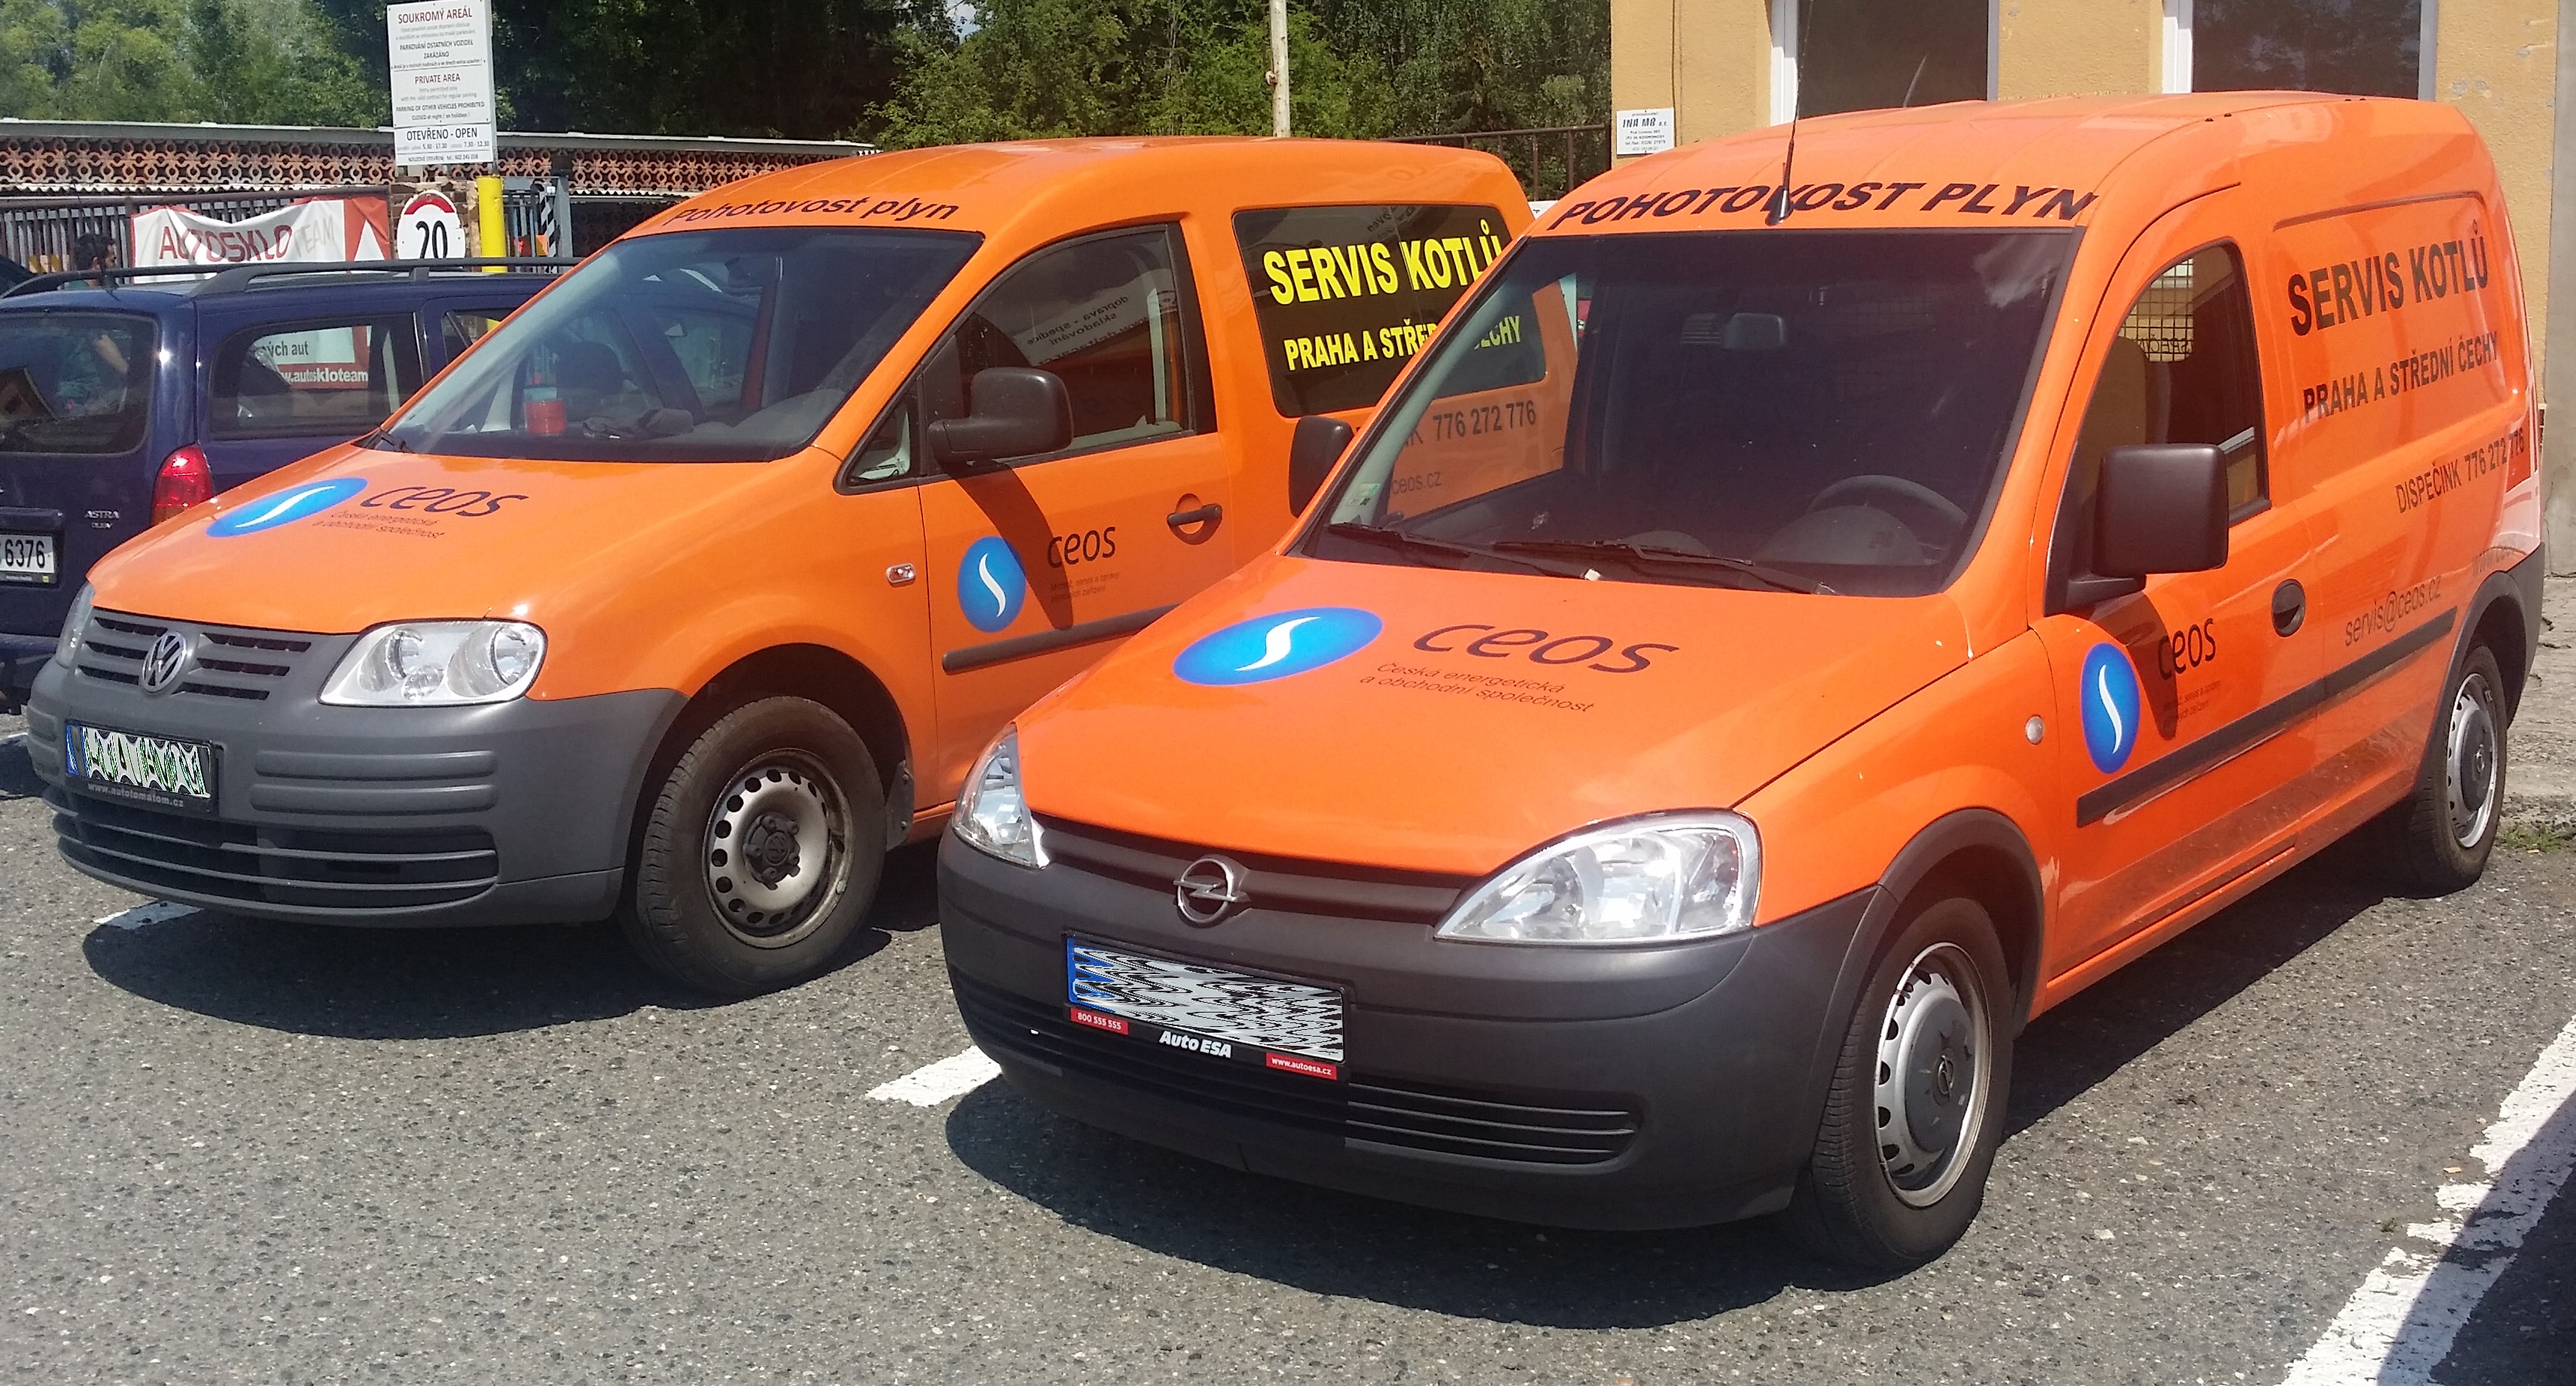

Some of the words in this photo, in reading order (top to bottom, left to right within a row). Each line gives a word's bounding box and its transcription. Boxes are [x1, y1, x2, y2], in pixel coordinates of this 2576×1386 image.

[398, 8, 444, 24] SOUKROMÝ
[446, 5, 473, 19] AREÁL
[424, 51, 449, 59] ZAKÁZÁNO
[415, 75, 442, 84] PRIVATE
[443, 73, 461, 82] AREA
[406, 128, 449, 141] OTEVŘENO
[455, 127, 478, 139] OPEN
[1642, 117, 1656, 127] MB
[662, 196, 871, 227] Pohotovost
[859, 196, 960, 222] plyn
[1546, 182, 1927, 231] POHOTOVOST
[1920, 183, 2099, 221] PLYN
[159, 224, 293, 263] AUTOSKLO
[415, 220, 449, 259] 20
[1263, 242, 1399, 306] SERVIS
[1399, 218, 1503, 292] KOTLŮ
[2288, 251, 2404, 337] SERVIS
[2408, 219, 2489, 303] KOTLŮ
[291, 340, 309, 356] aut
[1283, 332, 1360, 371] PRAHA
[1362, 330, 1379, 361] A
[2303, 372, 2369, 424] PRAHA
[2374, 367, 2386, 401] A
[2389, 337, 2454, 396] STŘEDNÍ
[2457, 331, 2498, 373] ČECHY
[1433, 410, 1466, 441] 776
[1470, 405, 1503, 435] 272
[1506, 400, 1537, 429] 776
[2395, 459, 2462, 513] DISPEČINK
[2464, 448, 2486, 482] 776
[2487, 437, 2507, 472] 272
[2508, 427, 2525, 459] 776
[84, 510, 120, 519] ASTRA
[360, 486, 530, 517] ceos
[1047, 526, 1116, 568] ceos
[2345, 574, 2442, 647] servis@ceos.cz
[1413, 624, 1679, 674] ceos
[2157, 617, 2216, 681] ceos
[1360, 675, 1376, 684] a
[1379, 675, 1472, 696] obchodní
[1475, 687, 1596, 713] společnost
[1377, 662, 1442, 678] Česká
[1443, 669, 1566, 694] energetická
[1077, 1012, 1092, 1022] 800
[1093, 1015, 1107, 1026] 555
[1107, 1019, 1122, 1031] 555
[1159, 1030, 1200, 1052] Auto
[1200, 1037, 1232, 1059] ESA
[1271, 1056, 1332, 1077] www.autoesa.cz
